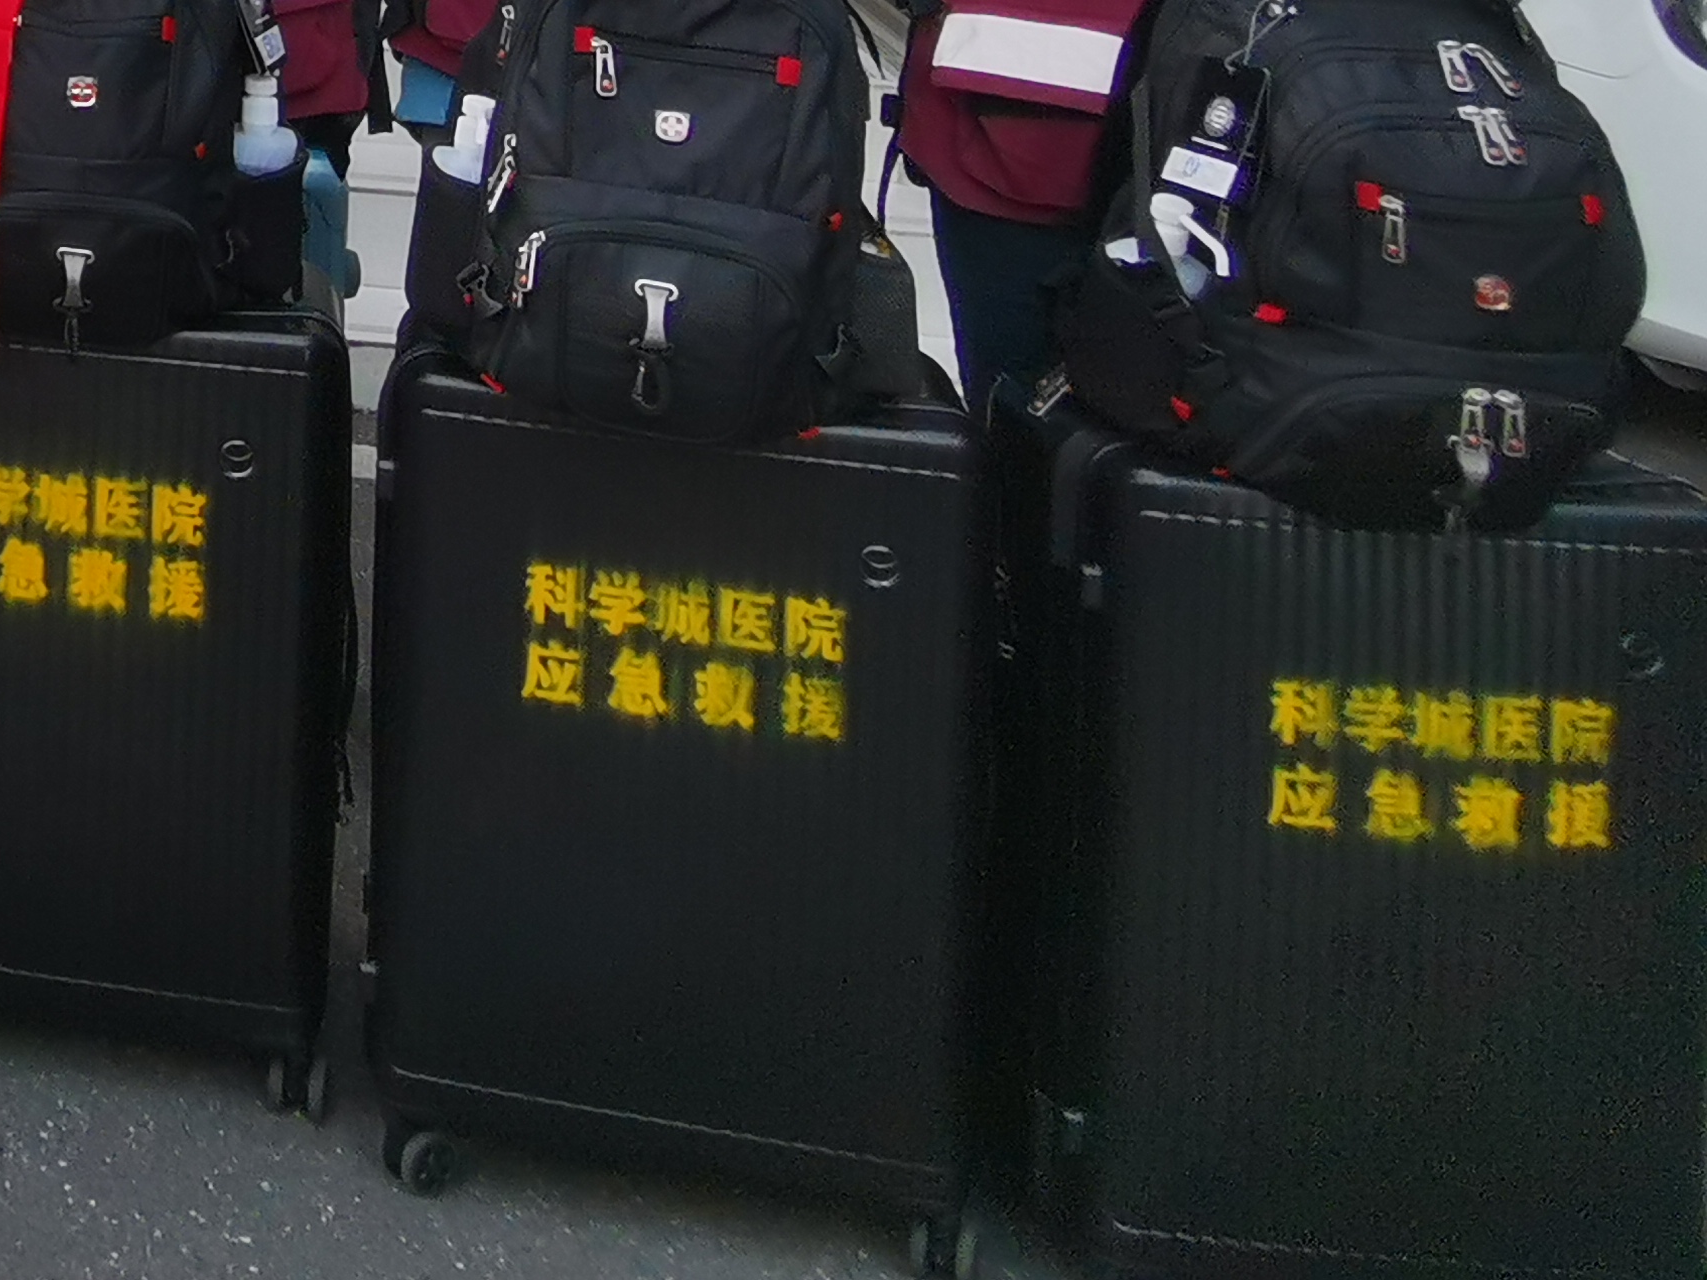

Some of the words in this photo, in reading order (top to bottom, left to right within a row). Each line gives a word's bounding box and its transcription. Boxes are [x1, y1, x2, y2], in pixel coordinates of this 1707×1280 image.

[526, 563, 845, 662] 科学城医院
[523, 640, 842, 740] 应急救援
[1273, 681, 1612, 763] 科学城医院
